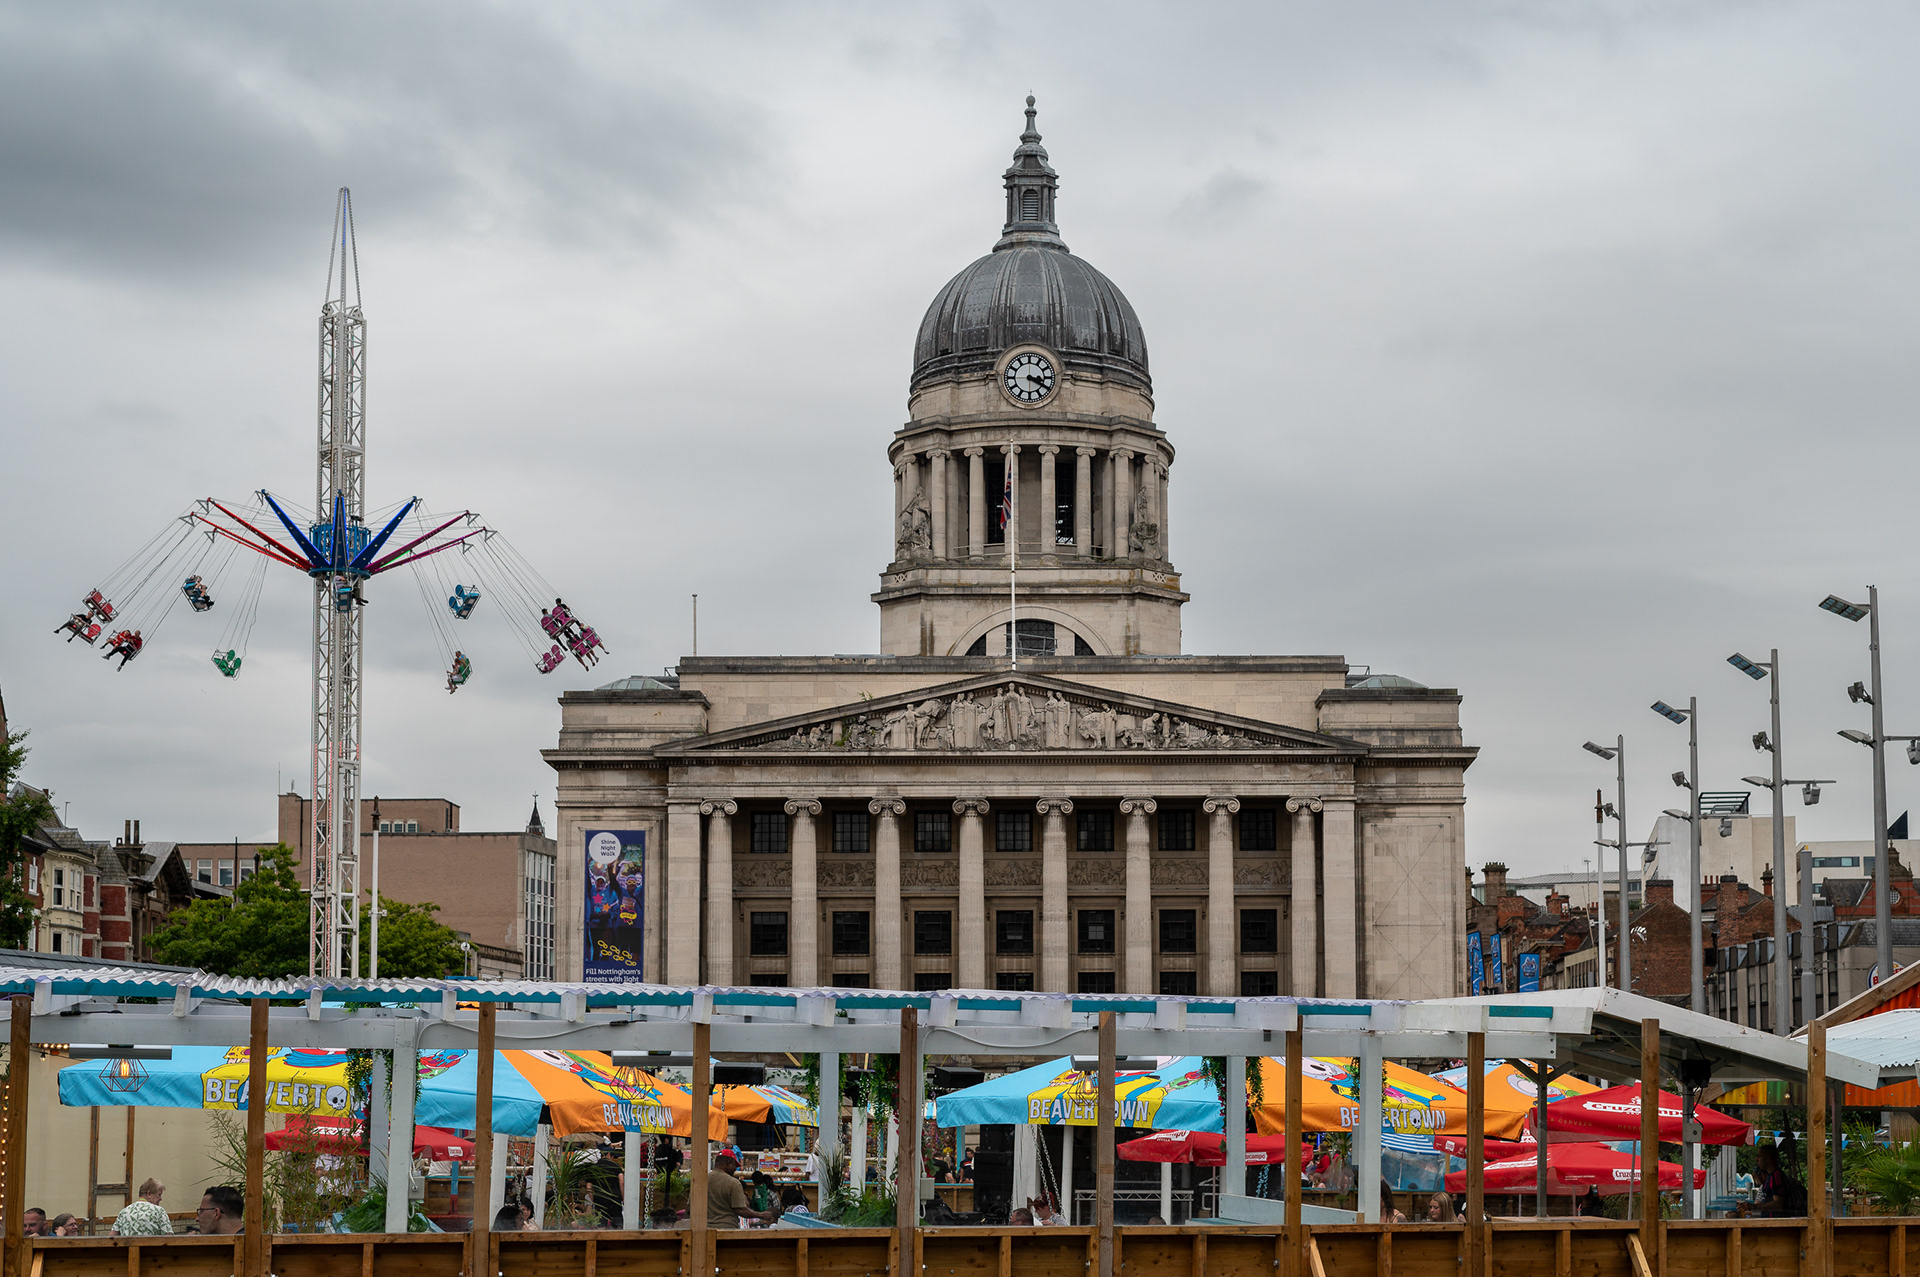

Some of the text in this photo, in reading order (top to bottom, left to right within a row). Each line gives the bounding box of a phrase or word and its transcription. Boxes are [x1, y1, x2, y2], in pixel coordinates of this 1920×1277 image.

[598, 968, 641, 976] Nottingham's
[608, 975, 623, 983] with
[624, 975, 639, 984] light
[602, 1103, 674, 1129] BEAVERTOWN
[1340, 1106, 1446, 1130] BEERTOWN
